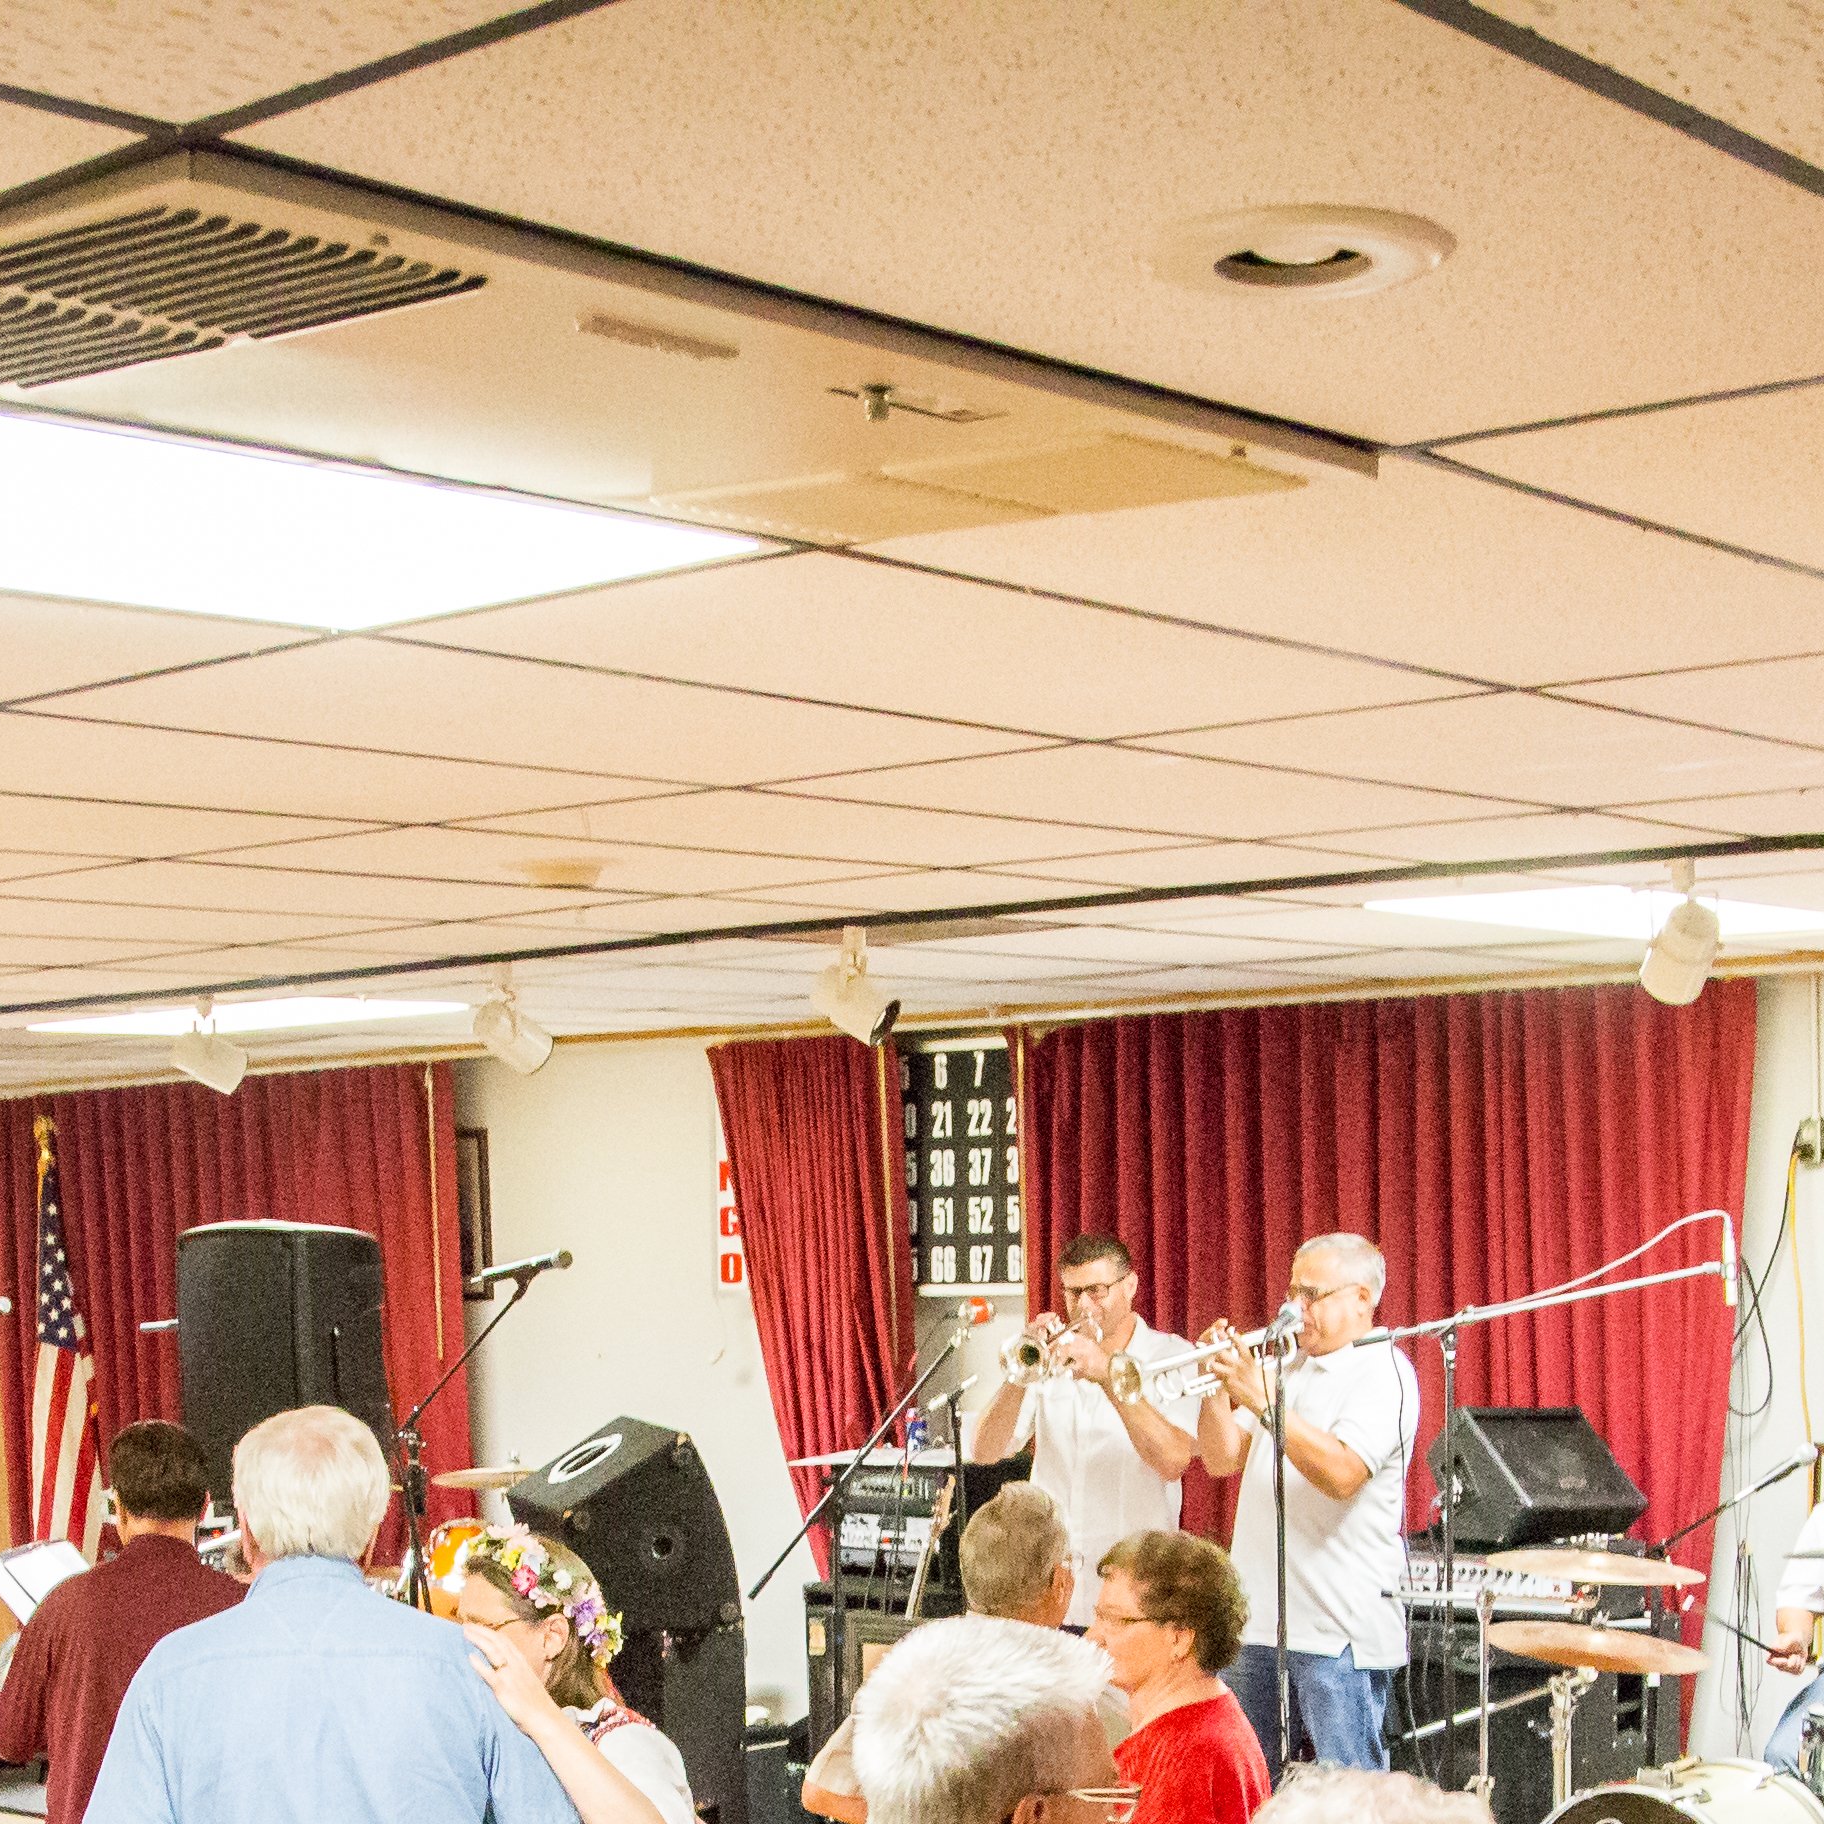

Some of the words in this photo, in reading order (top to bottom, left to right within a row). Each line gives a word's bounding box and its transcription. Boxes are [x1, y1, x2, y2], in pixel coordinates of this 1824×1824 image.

[934, 1052, 948, 1090] 6
[973, 1050, 985, 1088] 7
[931, 1099, 953, 1139] 21
[966, 1098, 993, 1138] 22
[1005, 1096, 1017, 1135] 2
[930, 1148, 956, 1187] 36
[968, 1147, 993, 1186] 37
[1006, 1145, 1020, 1184] 3
[932, 1196, 954, 1235] 51
[967, 1195, 994, 1235] 52
[1006, 1194, 1020, 1234] 5
[930, 1245, 957, 1283] 66
[969, 1244, 994, 1283] 67
[1007, 1244, 1024, 1283] 6
